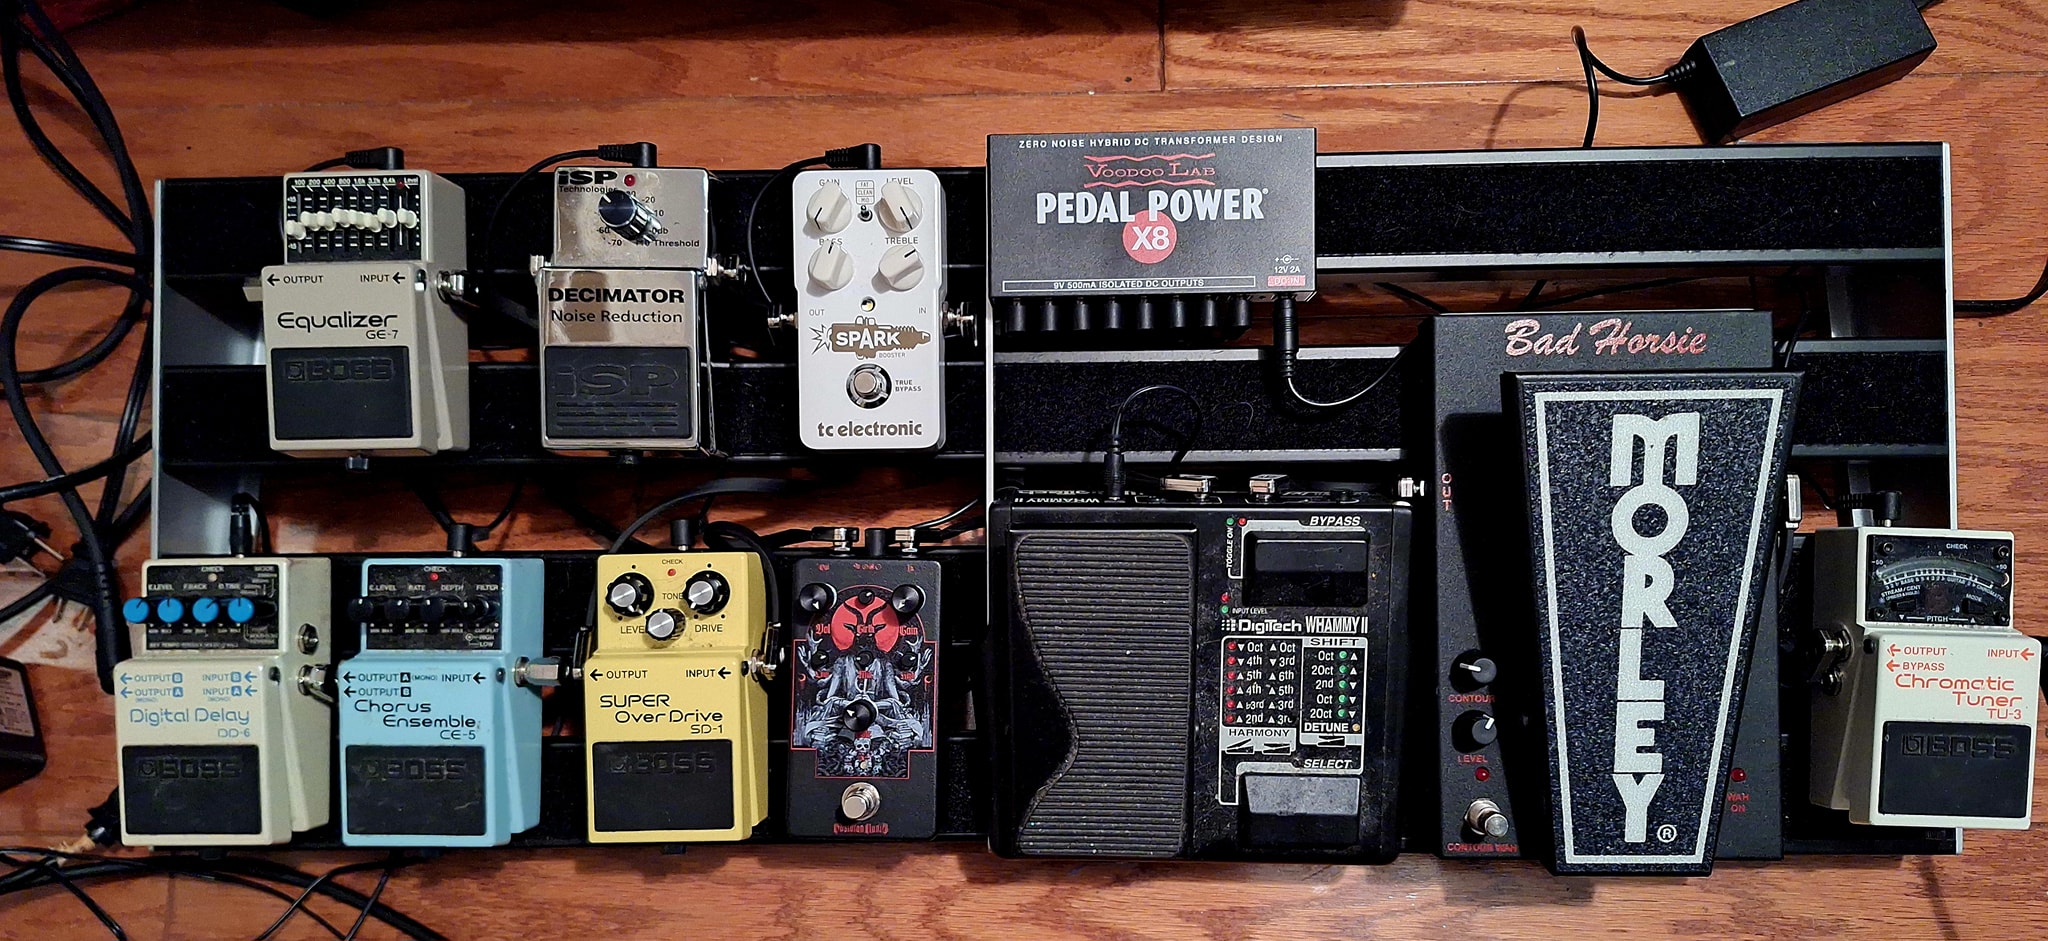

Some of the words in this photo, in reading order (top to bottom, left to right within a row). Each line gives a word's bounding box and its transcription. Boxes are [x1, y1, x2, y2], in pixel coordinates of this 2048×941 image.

[1019, 140, 1047, 149] ZERO
[1051, 139, 1085, 148] NOISE
[1090, 138, 1131, 147] HYBRID
[1134, 137, 1149, 146] DC
[1155, 135, 1236, 146] TRANSFORMER
[1242, 134, 1283, 144] DESIGN
[323, 178, 335, 186] 400
[819, 178, 840, 187] GN
[641, 196, 656, 204] -20
[1036, 190, 1136, 224] PEDAL
[1148, 187, 1265, 222] POWER
[607, 239, 622, 247] -70
[654, 239, 700, 247] Threshold
[885, 236, 919, 245] TREBLE
[1131, 226, 1170, 251] X8
[1274, 265, 1288, 274] 12V
[1290, 265, 1301, 273] 2A
[283, 275, 324, 284] OUTPUT
[360, 274, 390, 283] INPUT
[1067, 281, 1097, 289] 500mA
[1099, 281, 1141, 289] ISOLATED
[1145, 280, 1159, 288] DC
[1161, 279, 1204, 287] OUTPUTS
[548, 288, 685, 303] DECIMATOR
[551, 309, 596, 323] Noise
[601, 310, 683, 323] Reduction
[277, 311, 398, 333] Equalizer
[366, 329, 398, 340] GE-7
[836, 328, 901, 349] SPARK
[1504, 318, 1583, 356] Bad
[1589, 317, 1708, 355] Horsie
[817, 422, 834, 437] tc
[838, 420, 923, 437] electronic
[1441, 473, 1452, 512] OUT
[1309, 516, 1361, 526] BYPASS
[1227, 527, 1234, 538] ON
[1226, 540, 1234, 568] TOGGLE
[662, 592, 683, 600] TONE
[620, 625, 645, 634] LEVE
[695, 624, 723, 633] DRIVE
[900, 625, 918, 635] Gain
[1238, 619, 1302, 634] DigiTech
[1305, 616, 1360, 634] WHAMMY
[1361, 617, 1368, 634] II
[1610, 411, 1700, 842] MORLEY
[1247, 642, 1263, 653] Oct
[1280, 642, 1296, 653] Oct
[1310, 638, 1360, 646] SHIFT
[1318, 651, 1334, 661] Oct
[1904, 647, 1947, 656] OUTPUT
[1987, 649, 2019, 658] INPUT
[1246, 655, 1262, 666] 4th
[1279, 655, 1295, 667] 3rd
[1902, 662, 1945, 672] BYPASS
[134, 674, 171, 682] OUTPUT
[358, 673, 399, 682] OUTPUT
[400, 672, 411, 683] A
[441, 673, 471, 682] INPUT
[606, 670, 648, 679] OUTPUT
[686, 669, 715, 678] INPUT
[1246, 669, 1262, 681] 5th
[1278, 670, 1294, 681] 6th
[1315, 679, 1334, 690] 2nd
[1895, 673, 2015, 691] Chromatic
[134, 688, 172, 696] OUTPUT
[358, 688, 399, 696] OUTPUT
[1246, 683, 1261, 695] 4th
[1278, 684, 1294, 696] 5th
[600, 694, 670, 708] SUPER
[1316, 694, 1332, 704] Oct
[1448, 694, 1496, 703] CONTOUR
[1952, 691, 2023, 707] Tuner
[354, 699, 431, 713] Chorus
[1278, 699, 1294, 710] 3rd
[130, 708, 189, 727] Digital
[195, 707, 249, 725] Delay
[615, 710, 665, 723] Over
[669, 709, 723, 723] Drive
[1246, 713, 1263, 724] 2nd
[1986, 708, 2022, 720] TU-3
[383, 714, 476, 728] Ensemble
[217, 728, 250, 738] DD-6
[690, 724, 723, 734] SD-1
[1304, 723, 1348, 732] DETUNE
[439, 729, 476, 740] CE-5
[1926, 735, 2015, 760] BOSS
[1304, 759, 1352, 769] SELECT
[1457, 755, 1488, 763] LEVEL
[1727, 792, 1750, 801] WAH
[1731, 804, 1746, 812] ON
